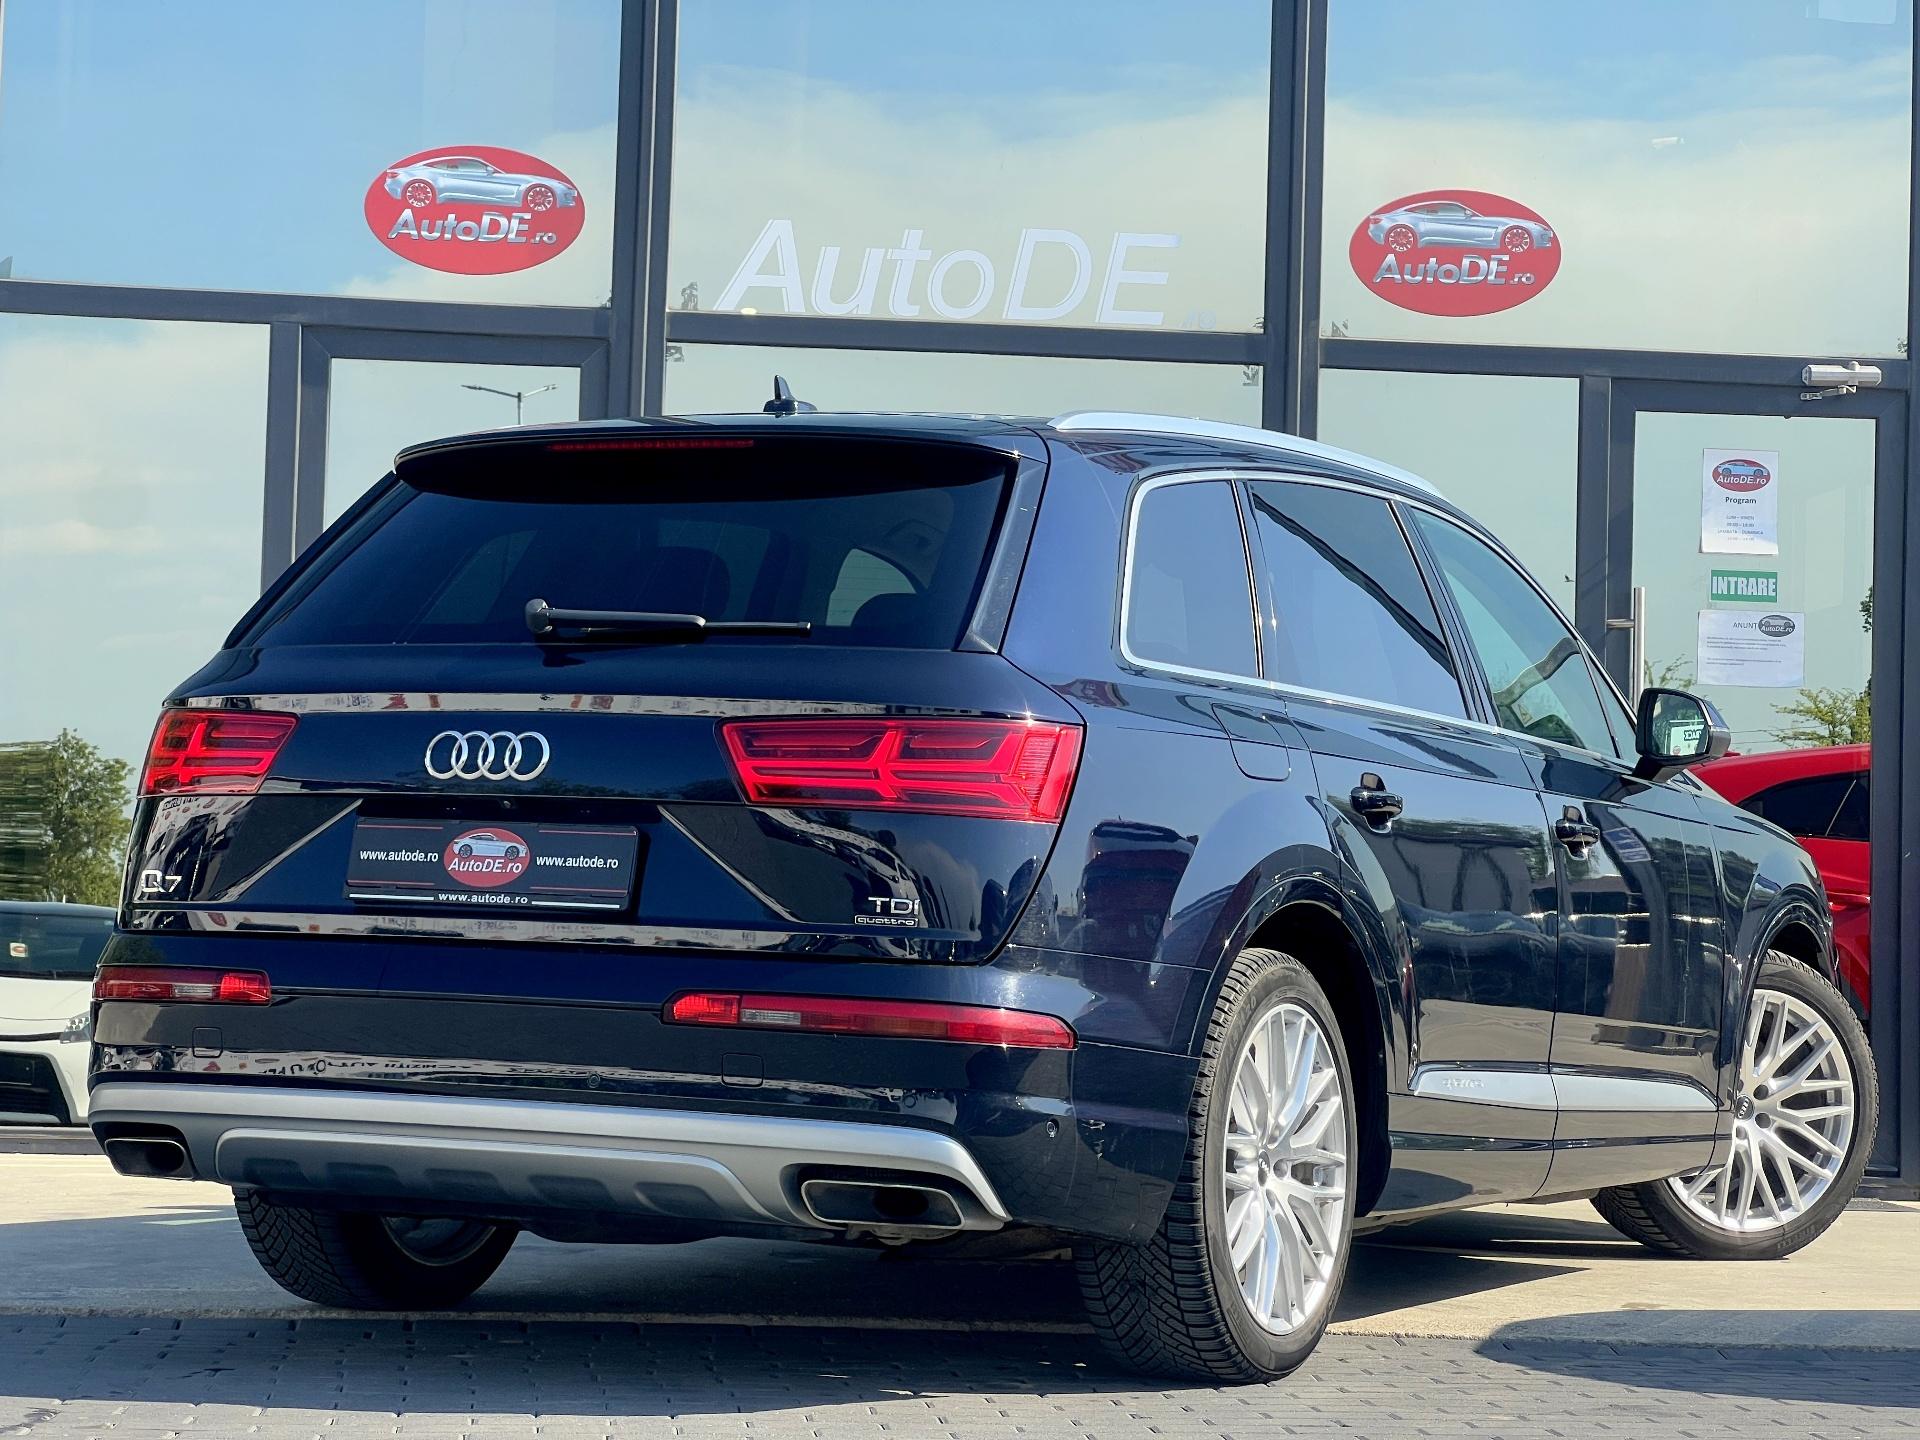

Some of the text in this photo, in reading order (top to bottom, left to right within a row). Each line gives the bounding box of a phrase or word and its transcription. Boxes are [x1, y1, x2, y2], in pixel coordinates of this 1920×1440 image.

[1725, 496, 1757, 505] Program
[1711, 576, 1777, 597] INTRARE
[359, 849, 439, 863] www.autode.ro
[535, 854, 619, 869] www.autode.ro
[448, 857, 523, 874] AutoDE.ro
[140, 869, 183, 893] Q7
[437, 892, 529, 905] www.autode.ro
[867, 896, 920, 915] TDI
[857, 916, 915, 926] quattro
